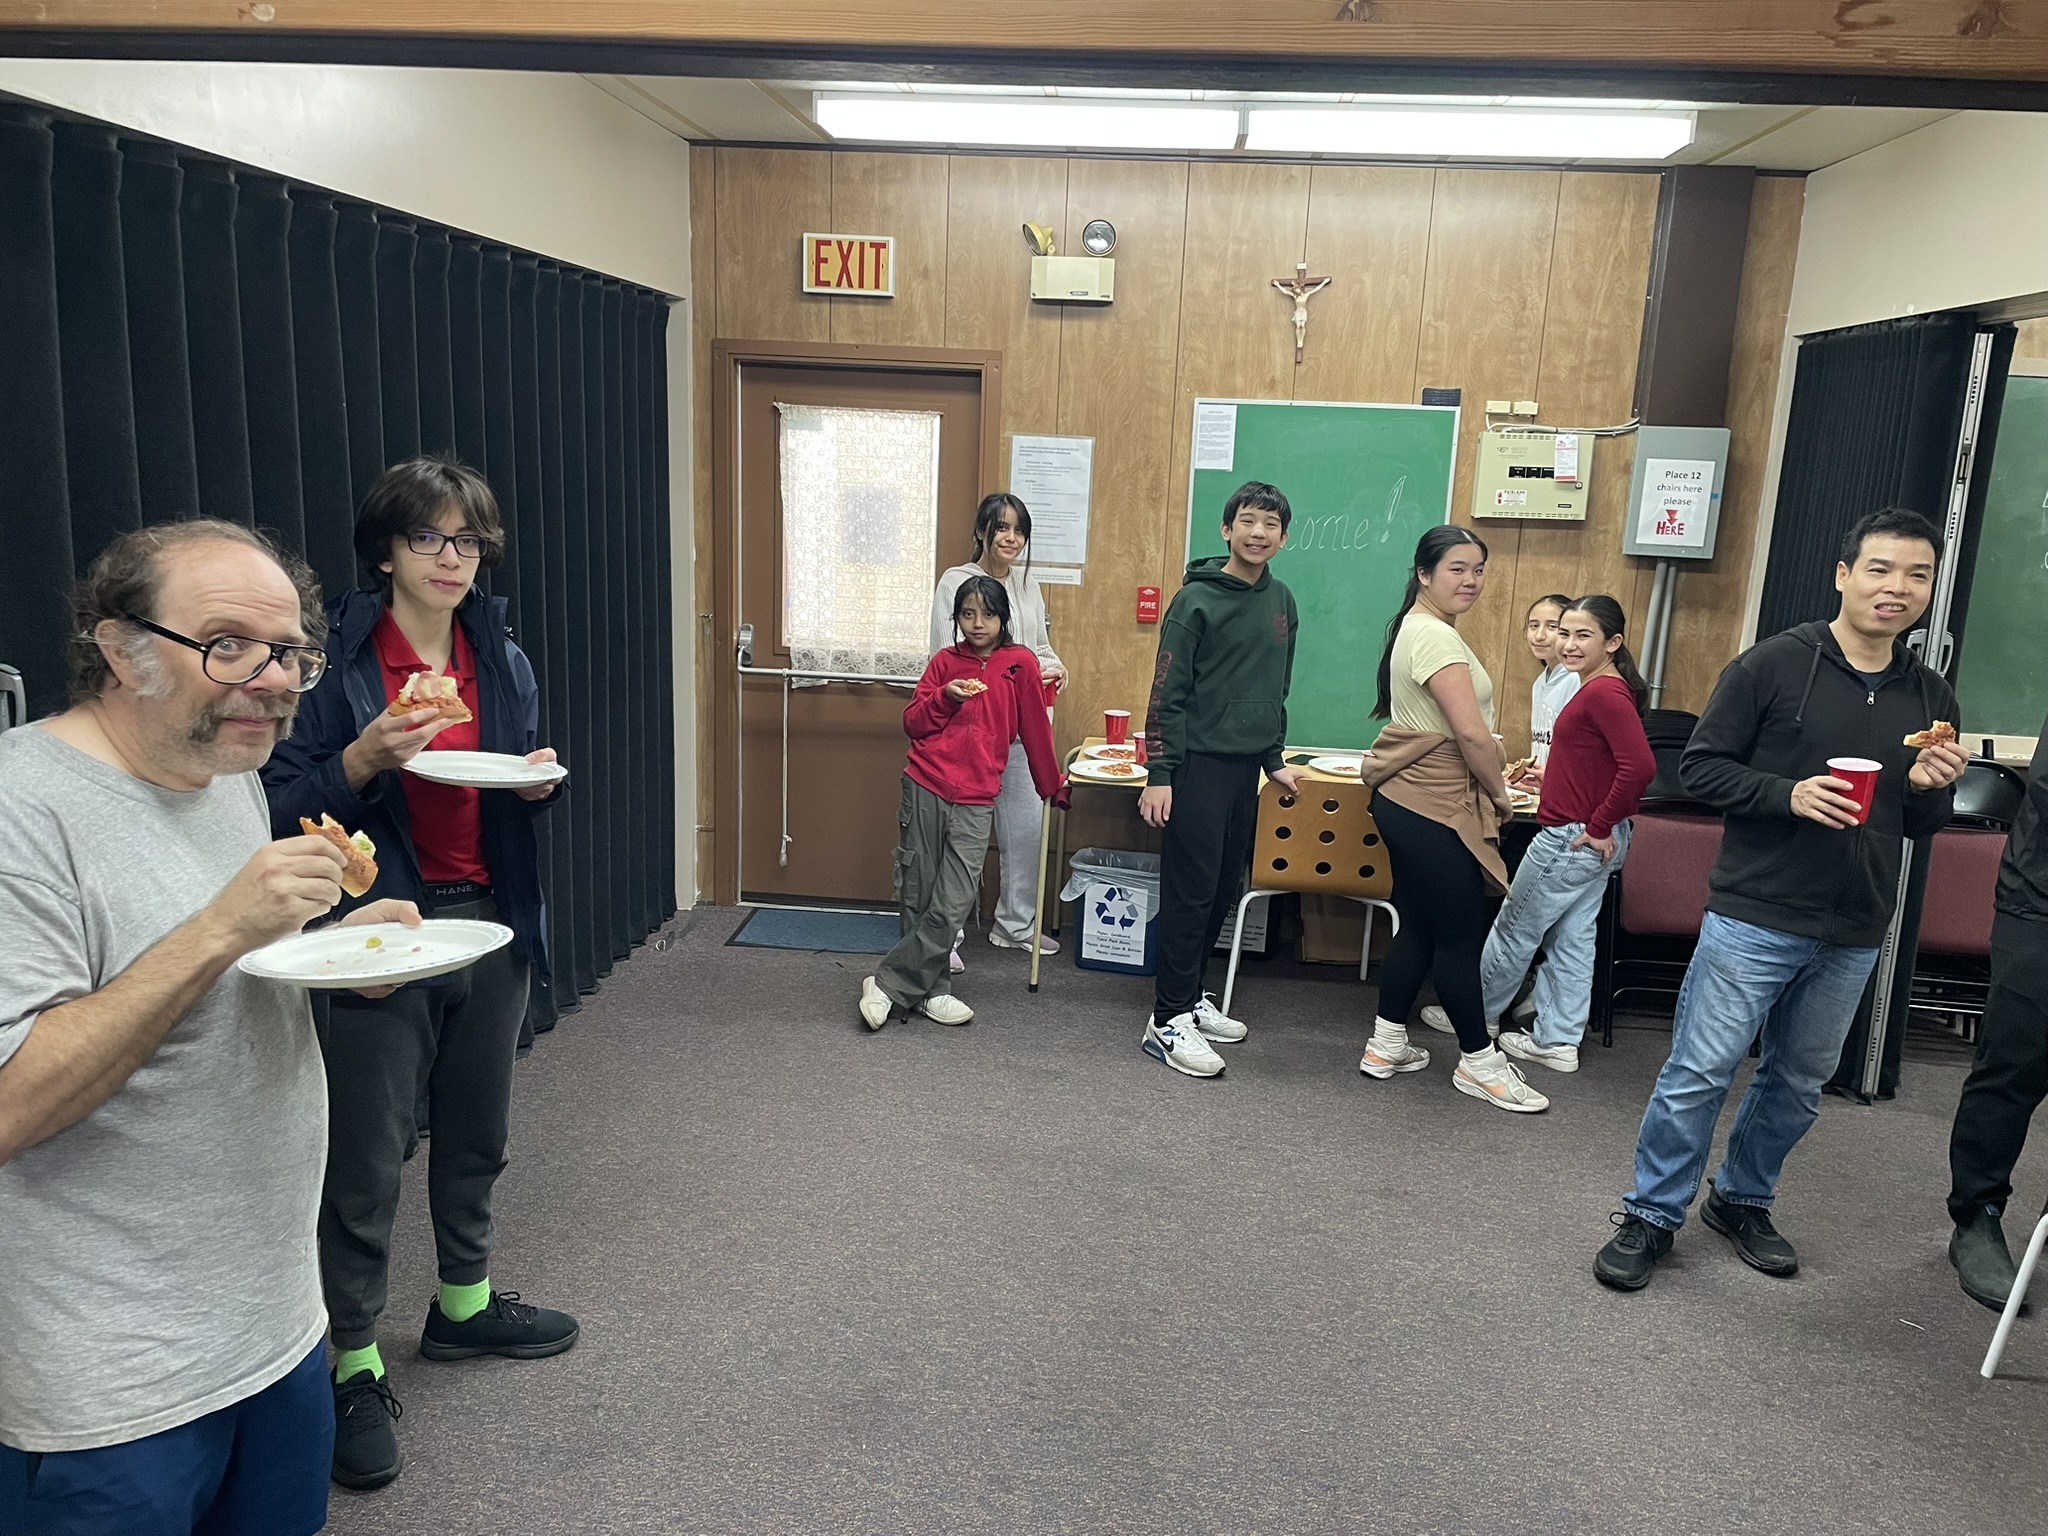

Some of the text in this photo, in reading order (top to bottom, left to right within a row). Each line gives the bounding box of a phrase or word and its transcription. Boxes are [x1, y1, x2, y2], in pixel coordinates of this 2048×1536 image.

[814, 239, 887, 290] EXIT
[1665, 470, 1702, 480] Place 12
[1683, 485, 1703, 493] here
[1663, 497, 1692, 506] please
[1656, 521, 1685, 536] HERE
[1140, 601, 1157, 610] FIRE
[436, 884, 479, 896] HANE
